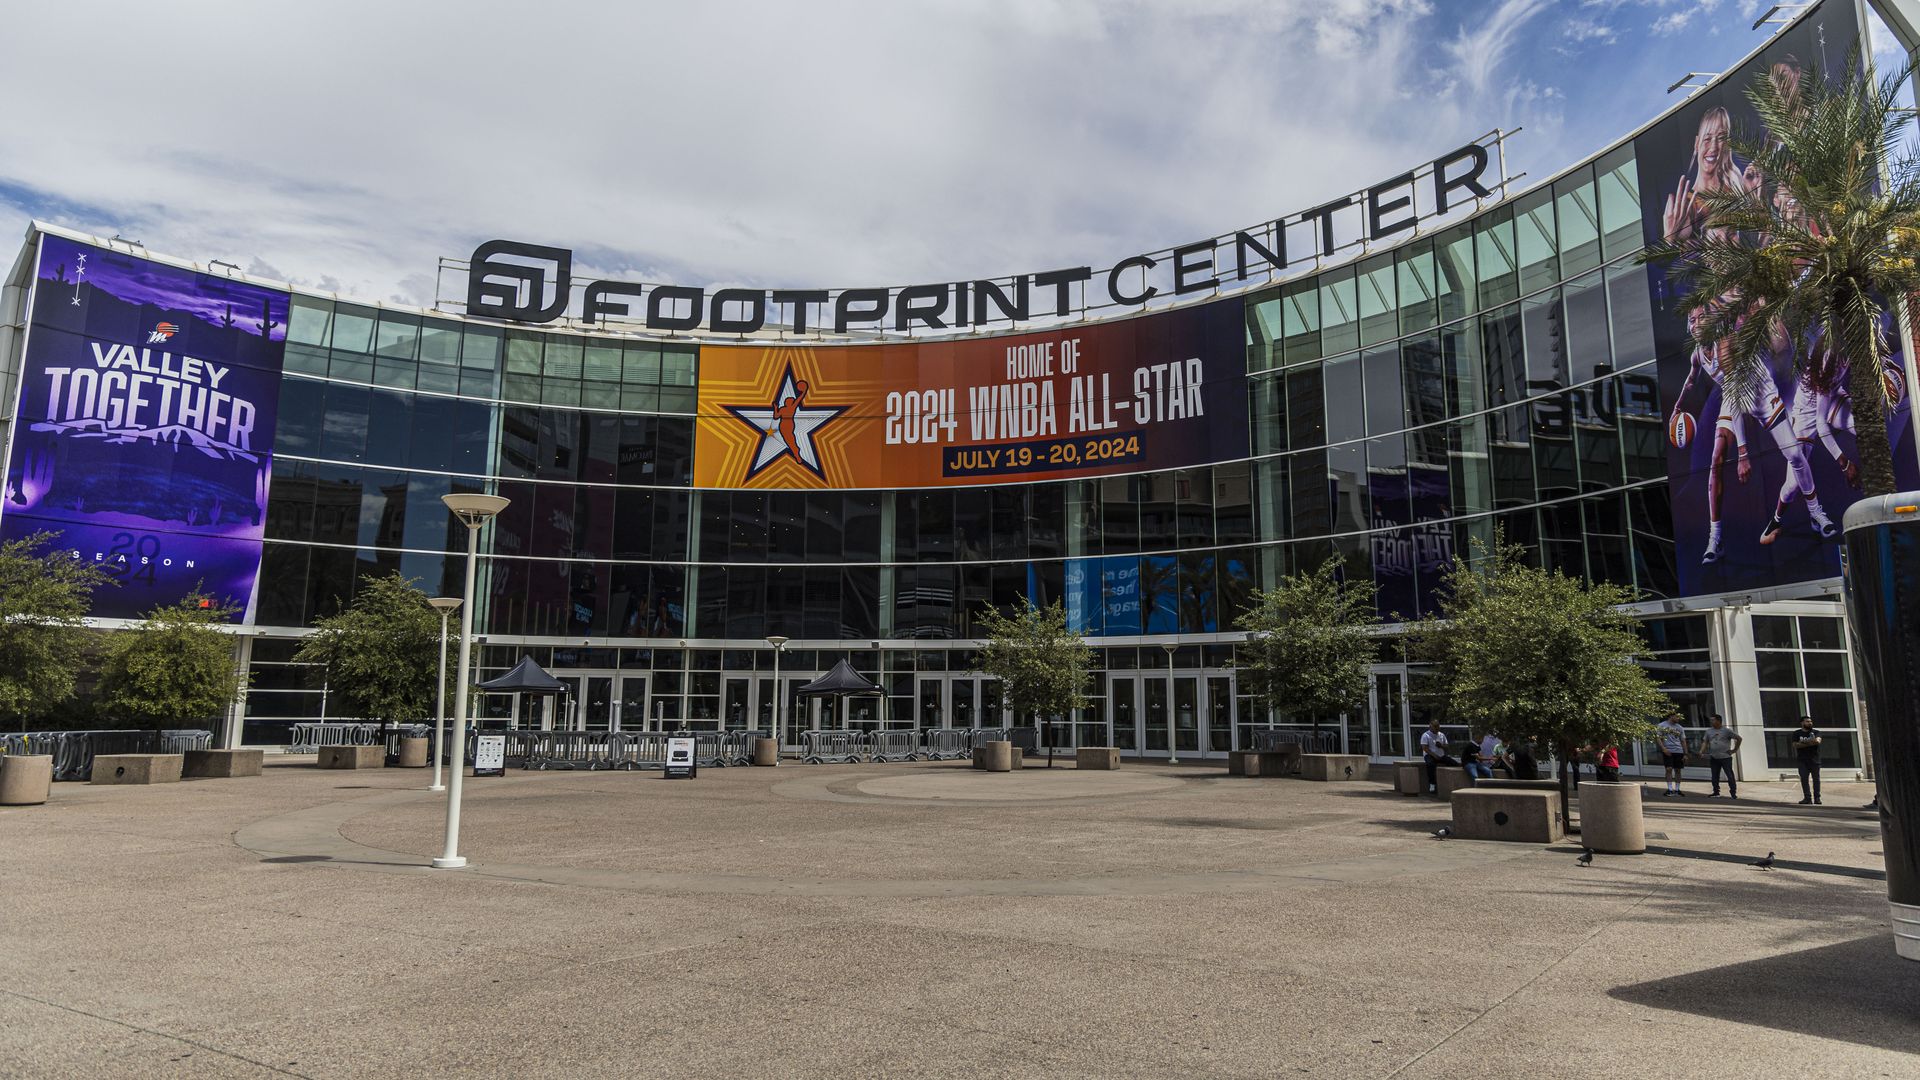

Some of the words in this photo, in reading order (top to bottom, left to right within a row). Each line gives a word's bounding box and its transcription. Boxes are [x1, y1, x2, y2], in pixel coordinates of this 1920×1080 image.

[583, 266, 1092, 334] FOOTPRINT
[1107, 144, 1492, 306] CENTER
[91, 342, 229, 390] VALLEY
[1007, 342, 1054, 381] HOME
[1061, 339, 1081, 374] OF
[44, 367, 256, 451] TOGETHER
[885, 388, 958, 445] 2024
[969, 379, 1056, 441] WNBA
[1068, 357, 1204, 433] ALL-STAR
[950, 449, 1001, 471] JULY
[1005, 447, 1033, 468] 19
[1085, 436, 1140, 461] 2024
[72, 550, 195, 568] SEASON
[110, 532, 161, 560] 20
